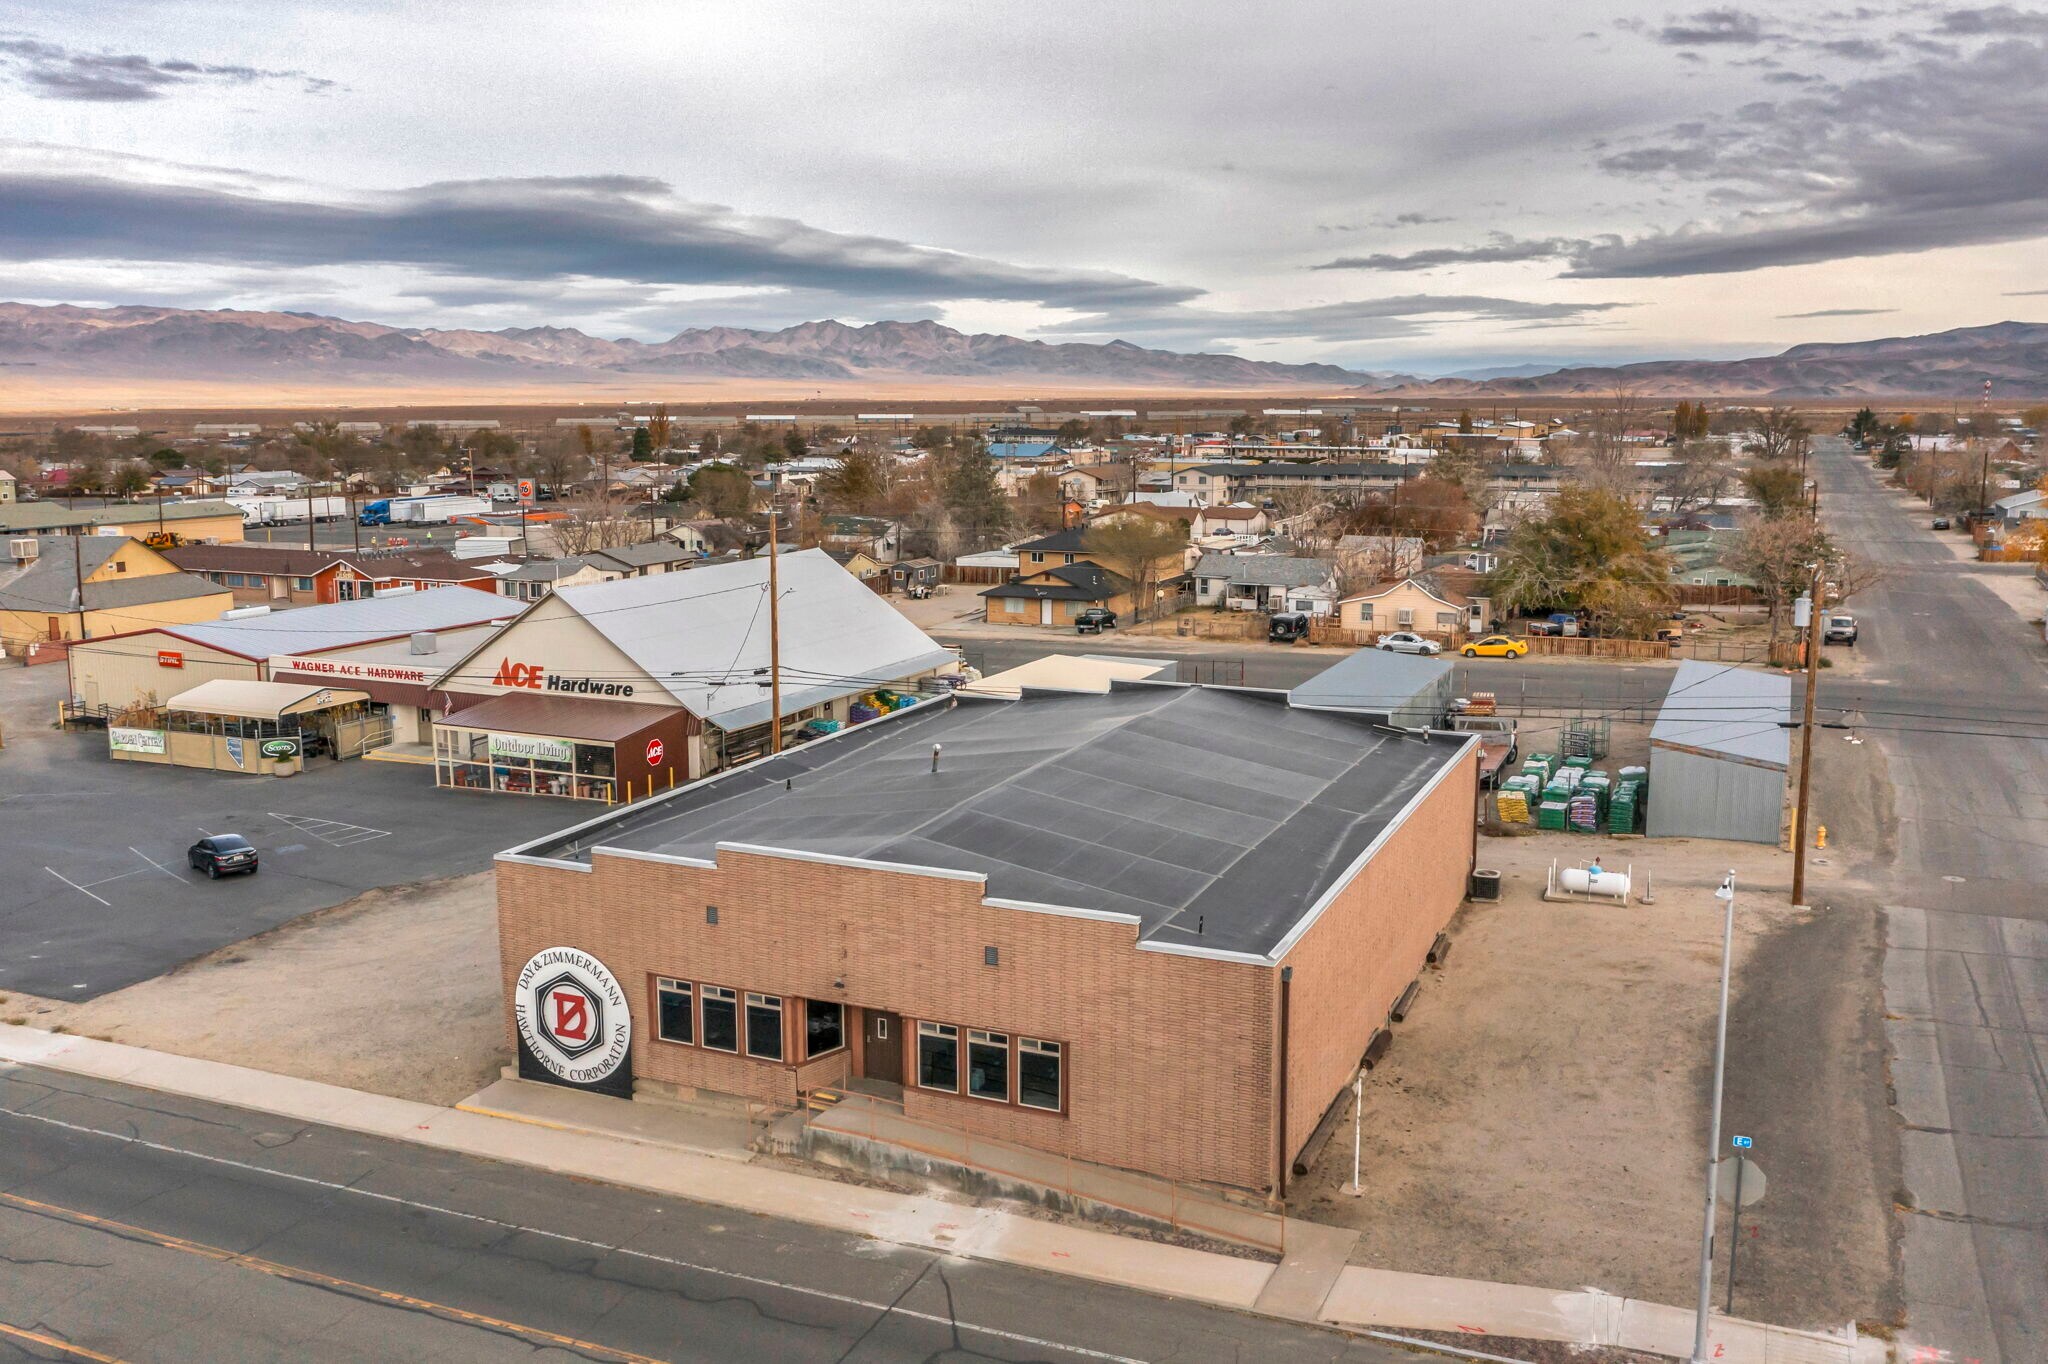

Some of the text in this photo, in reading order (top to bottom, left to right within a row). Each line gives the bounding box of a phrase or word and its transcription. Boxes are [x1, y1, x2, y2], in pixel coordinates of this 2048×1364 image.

[292, 660, 424, 682] WAGNER ACE HARDWARE
[492, 656, 633, 697] ACE Hardware
[648, 746, 663, 758] ACE
[515, 1004, 566, 1077] HAWTHORNE
[569, 1023, 626, 1081] CORPORATION
